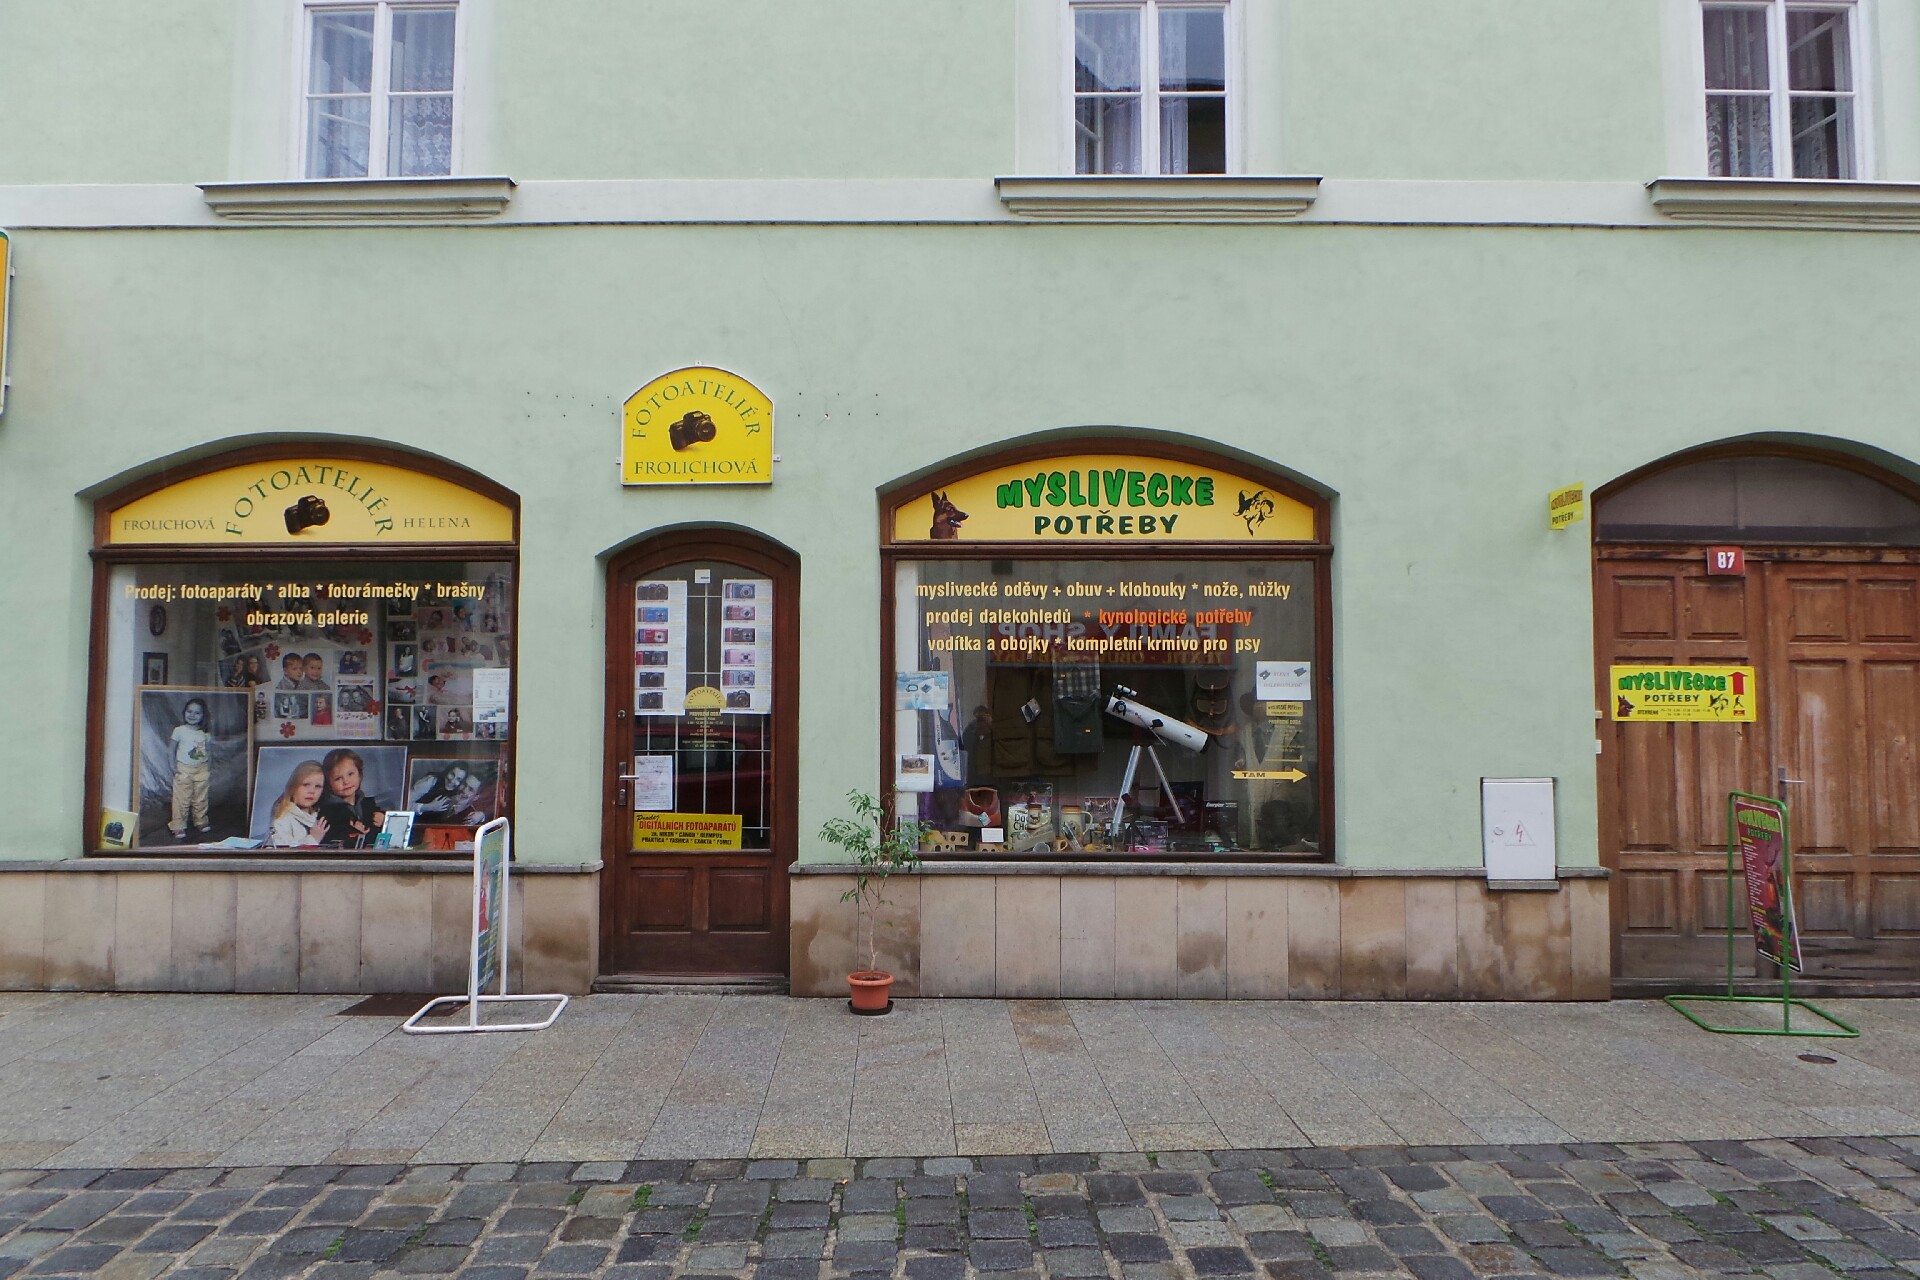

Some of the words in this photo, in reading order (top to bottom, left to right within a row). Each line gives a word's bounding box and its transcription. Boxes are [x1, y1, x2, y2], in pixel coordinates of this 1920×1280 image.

[632, 379, 760, 440] FOTOATELIÉR
[634, 457, 758, 475] FROLICHOVÁ
[225, 465, 393, 537] FOTOATELIÉR
[123, 516, 215, 531] FROLICHOVÁ
[404, 517, 471, 528] HELENA
[1034, 509, 1178, 535] POTŘEBY
[1718, 552, 1735, 569] 87
[125, 584, 176, 602] Prodej:
[180, 583, 263, 602] fotoaparáty
[278, 584, 310, 598] alba
[328, 582, 419, 601] fotorámečky
[437, 582, 486, 601] brašny
[916, 582, 998, 600] myslivecké
[1004, 582, 1048, 600] oděvy
[1066, 582, 1103, 597] obuv
[1120, 582, 1187, 600] klobouky
[1204, 582, 1244, 599] nože,
[1248, 582, 1291, 600] nůžky
[246, 609, 313, 626] obrazová
[317, 610, 369, 628] galerie
[926, 608, 974, 627] prodej
[979, 608, 1071, 624] dalekohledů
[1099, 608, 1187, 627] kynologické
[1195, 608, 1252, 627] potřeby
[928, 636, 982, 651] vodítka
[987, 640, 996, 651] a
[1000, 636, 1049, 654] obojky
[1067, 636, 1144, 655] kompletní
[1148, 636, 1199, 651] krmivo
[1204, 638, 1228, 654] pro
[1236, 638, 1261, 654] psy
[1644, 692, 1700, 703] POTŘEBY
